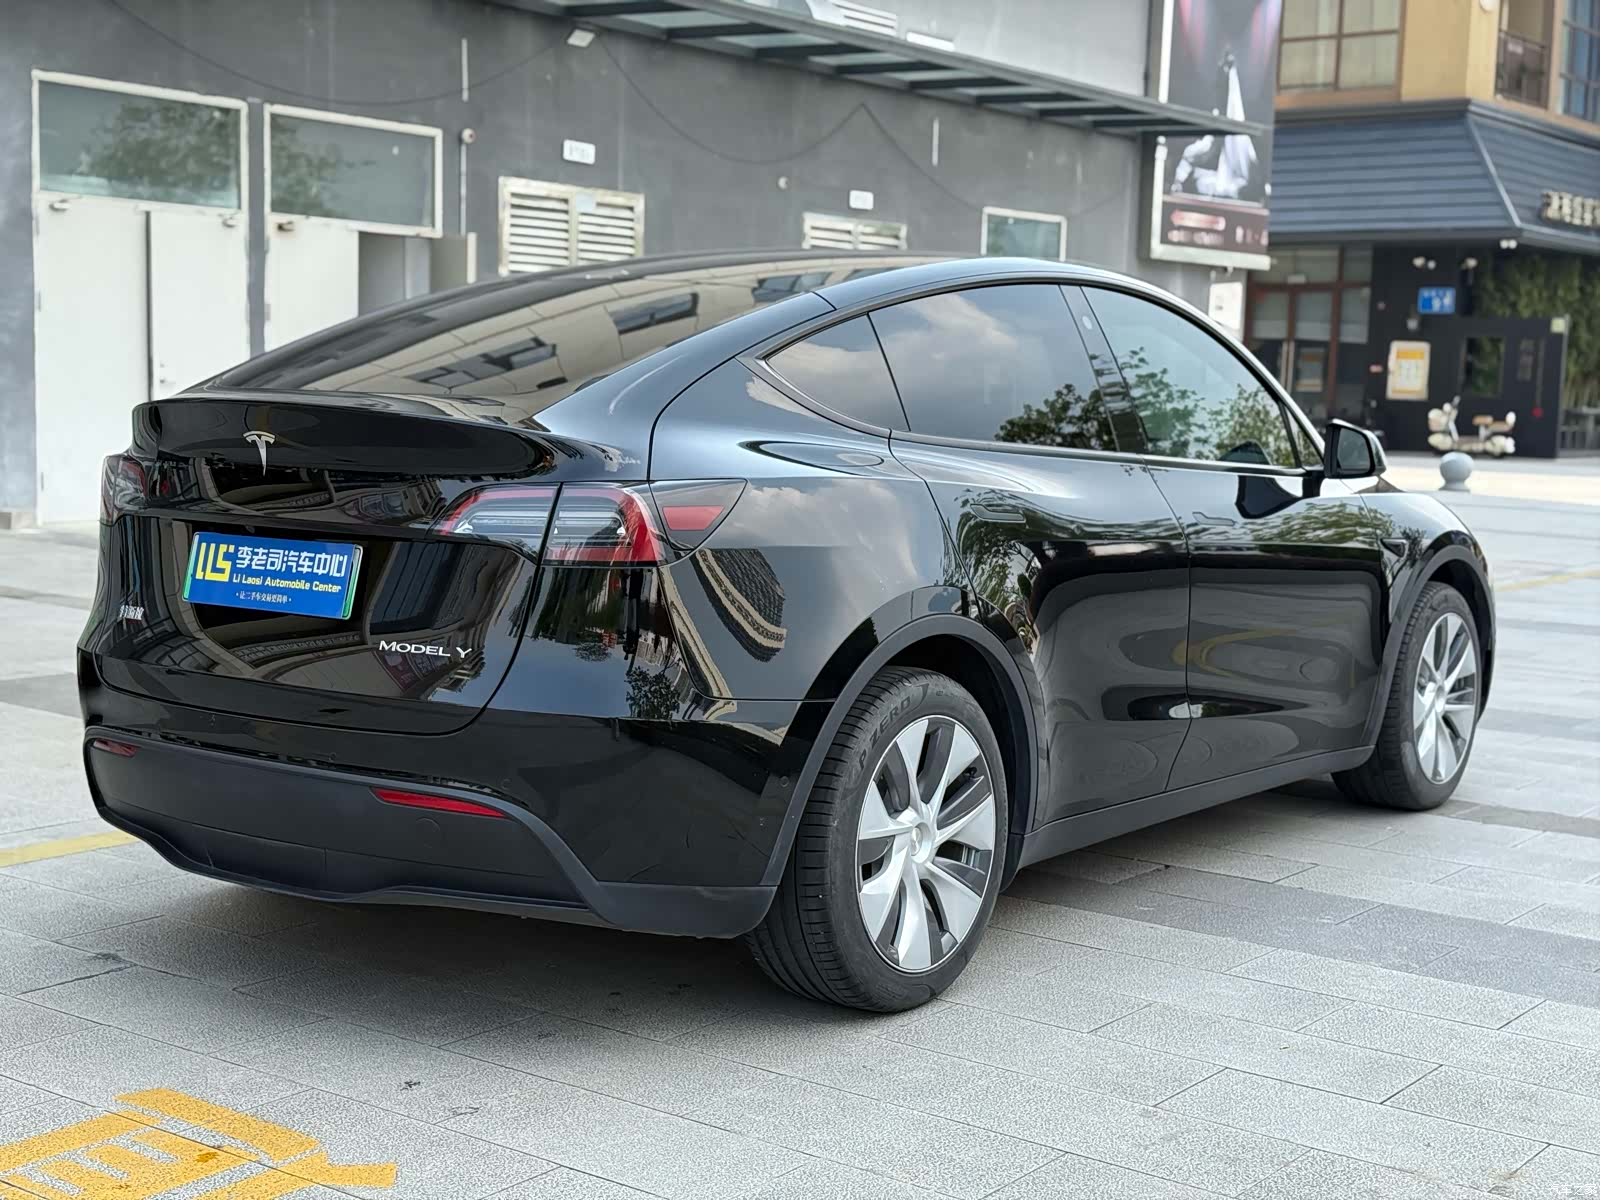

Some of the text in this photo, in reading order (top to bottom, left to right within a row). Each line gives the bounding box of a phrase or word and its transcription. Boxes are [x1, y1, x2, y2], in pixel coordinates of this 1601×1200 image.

[236, 545, 348, 577] 李老司汽车中心
[233, 573, 342, 593] Li Laosi Automobile Center
[378, 640, 473, 659] MODEL Y
[869, 696, 911, 750] ZERO
